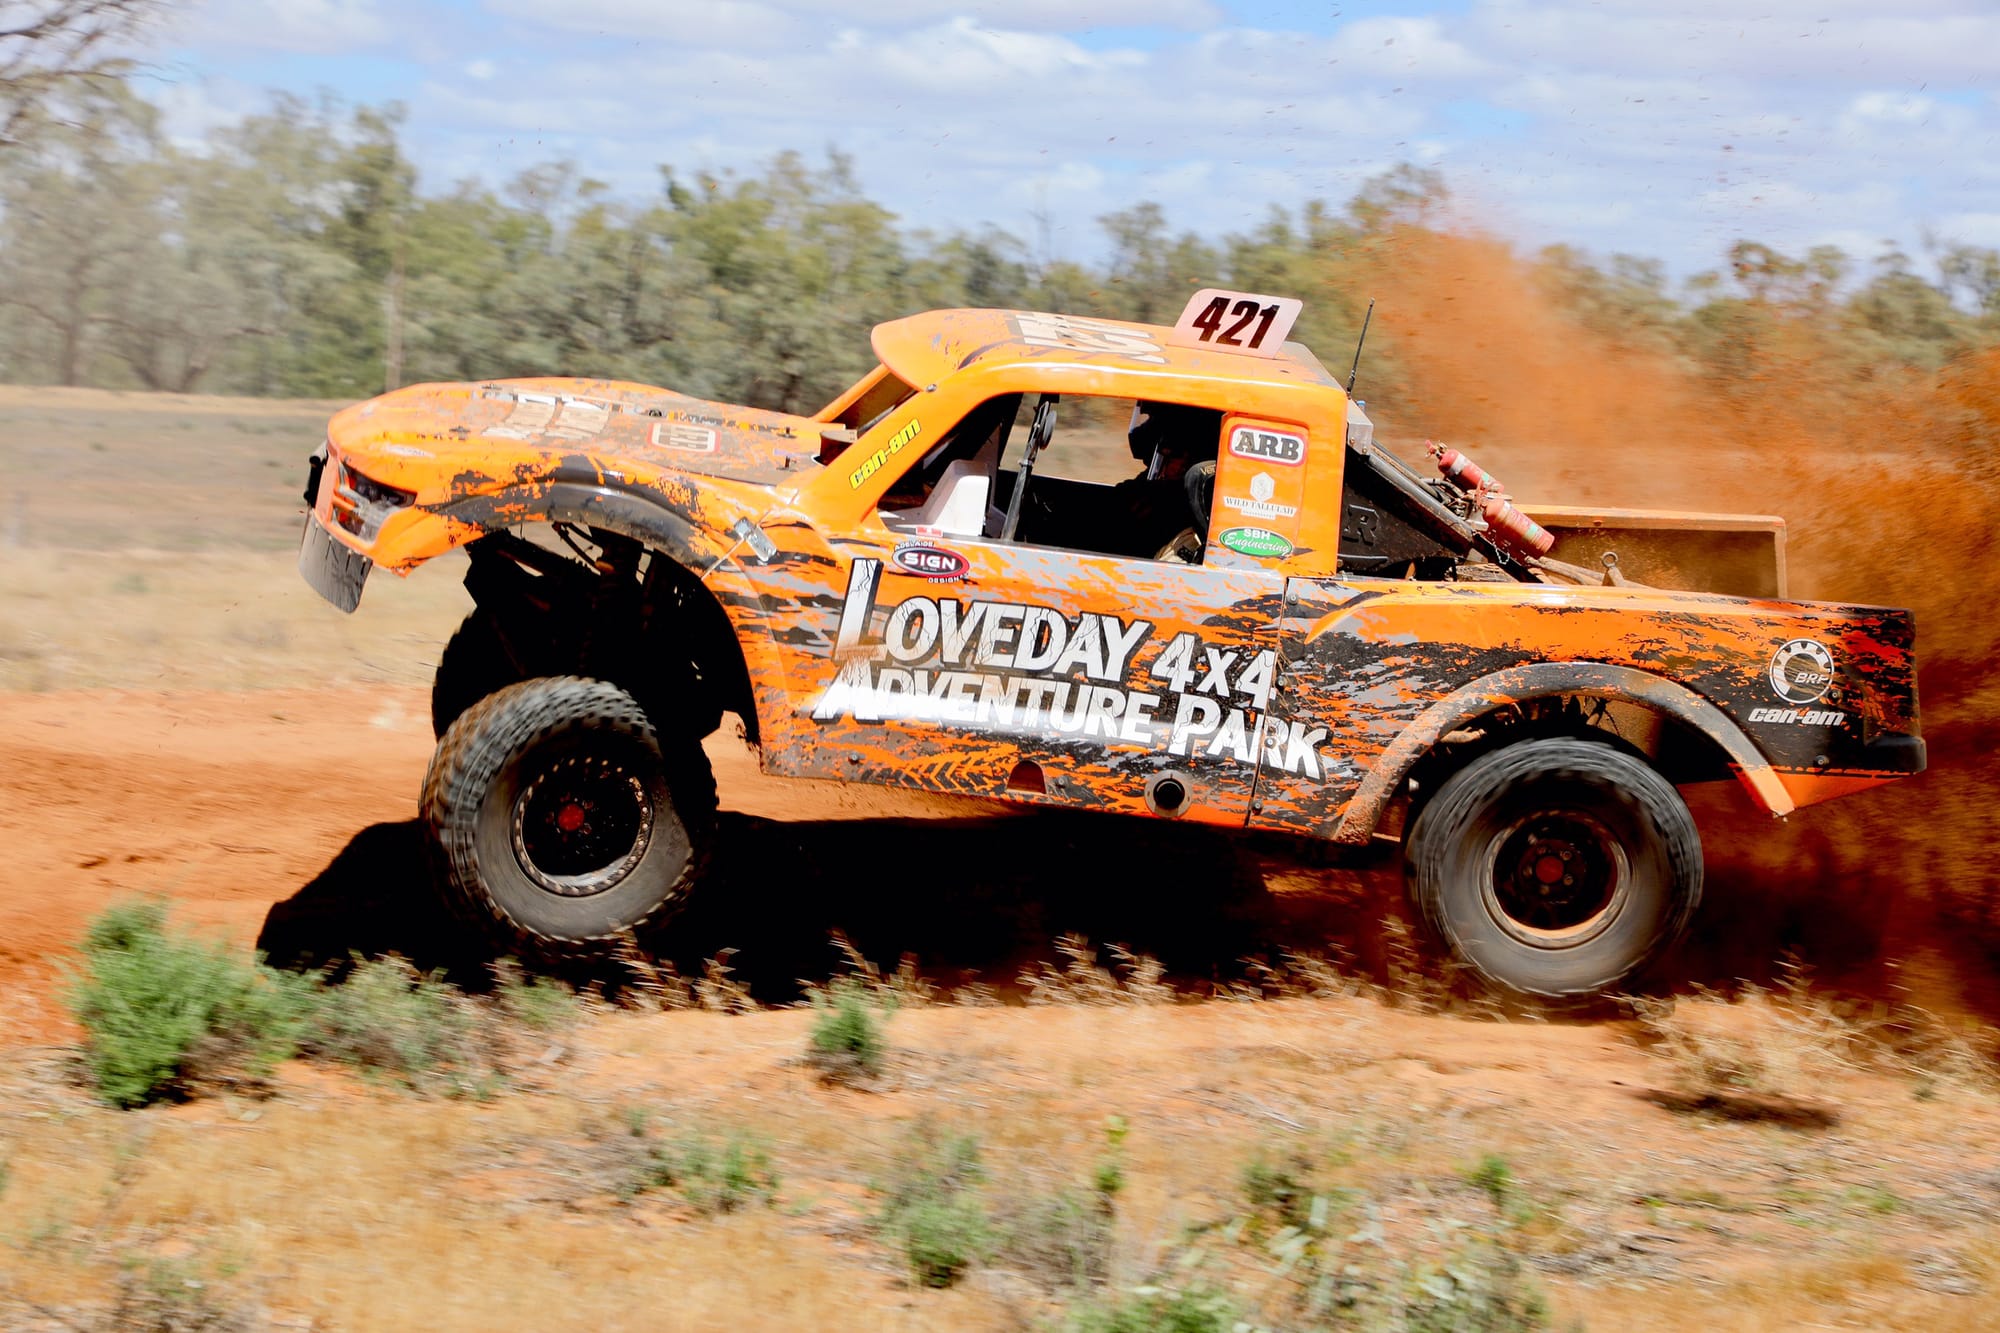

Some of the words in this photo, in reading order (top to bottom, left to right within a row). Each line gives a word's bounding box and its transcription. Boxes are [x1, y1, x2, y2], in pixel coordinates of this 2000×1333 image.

[1192, 296, 1280, 349] 421
[849, 418, 921, 490] can-am
[1234, 430, 1299, 461] ARB
[1225, 496, 1248, 507] WILD
[1250, 501, 1295, 516] TALLULAH
[1224, 532, 1290, 556] Engineering
[1243, 528, 1271, 541] SBH
[904, 552, 956, 570] SIGN
[834, 558, 1151, 682] LOVEDAY
[1795, 672, 1829, 684] BRP
[811, 660, 1161, 745] ADVENTURE
[1168, 693, 1330, 780] PARK
[1748, 707, 1845, 726] can-am
